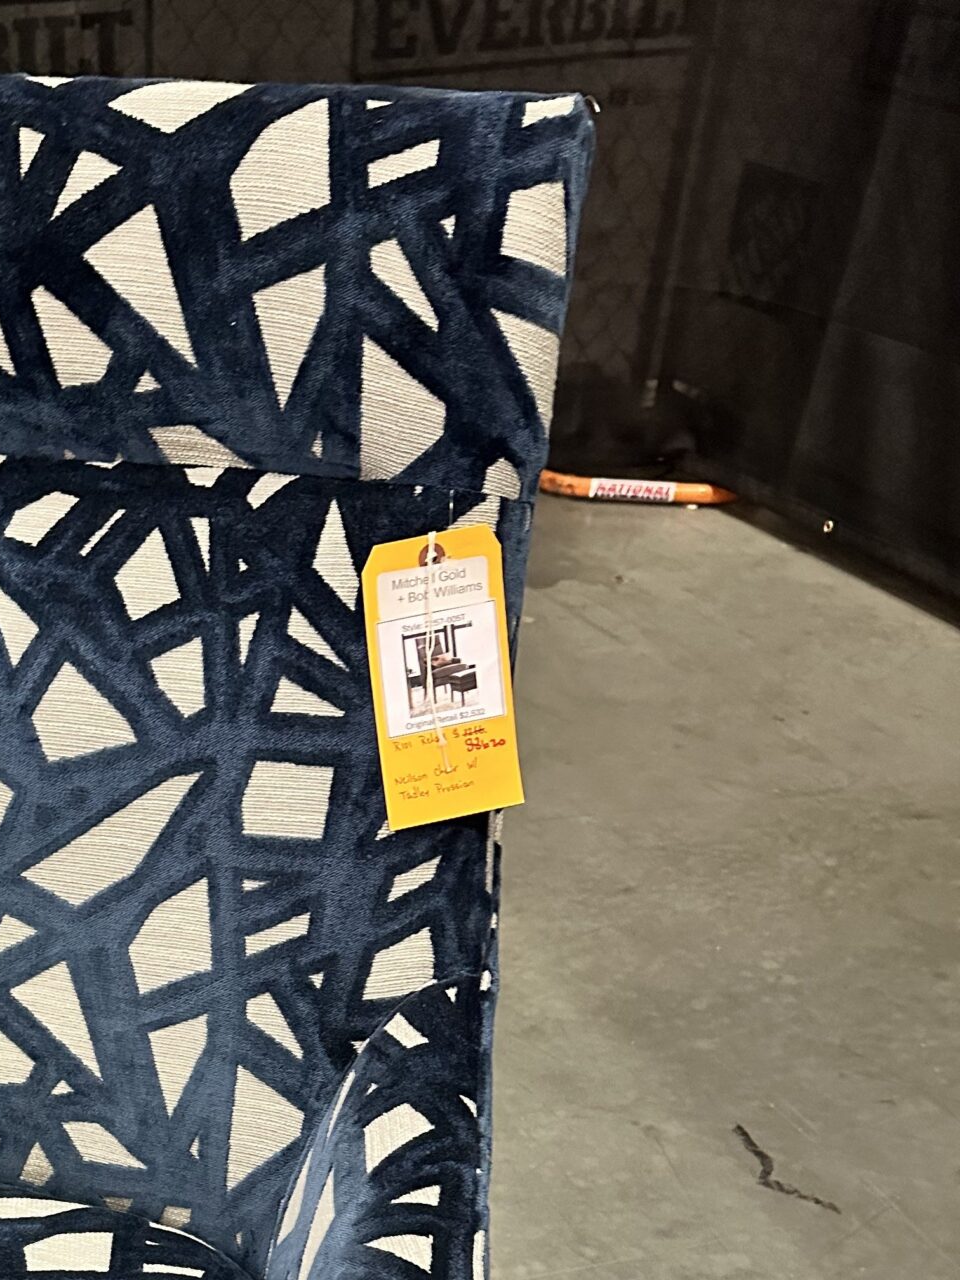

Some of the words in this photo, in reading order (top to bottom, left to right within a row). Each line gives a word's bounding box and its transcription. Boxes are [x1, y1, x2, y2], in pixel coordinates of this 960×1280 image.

[596, 482, 671, 496] NATIONAL
[392, 572, 435, 590] Mitchel
[439, 567, 466, 582] Gold
[434, 582, 483, 598] Williams
